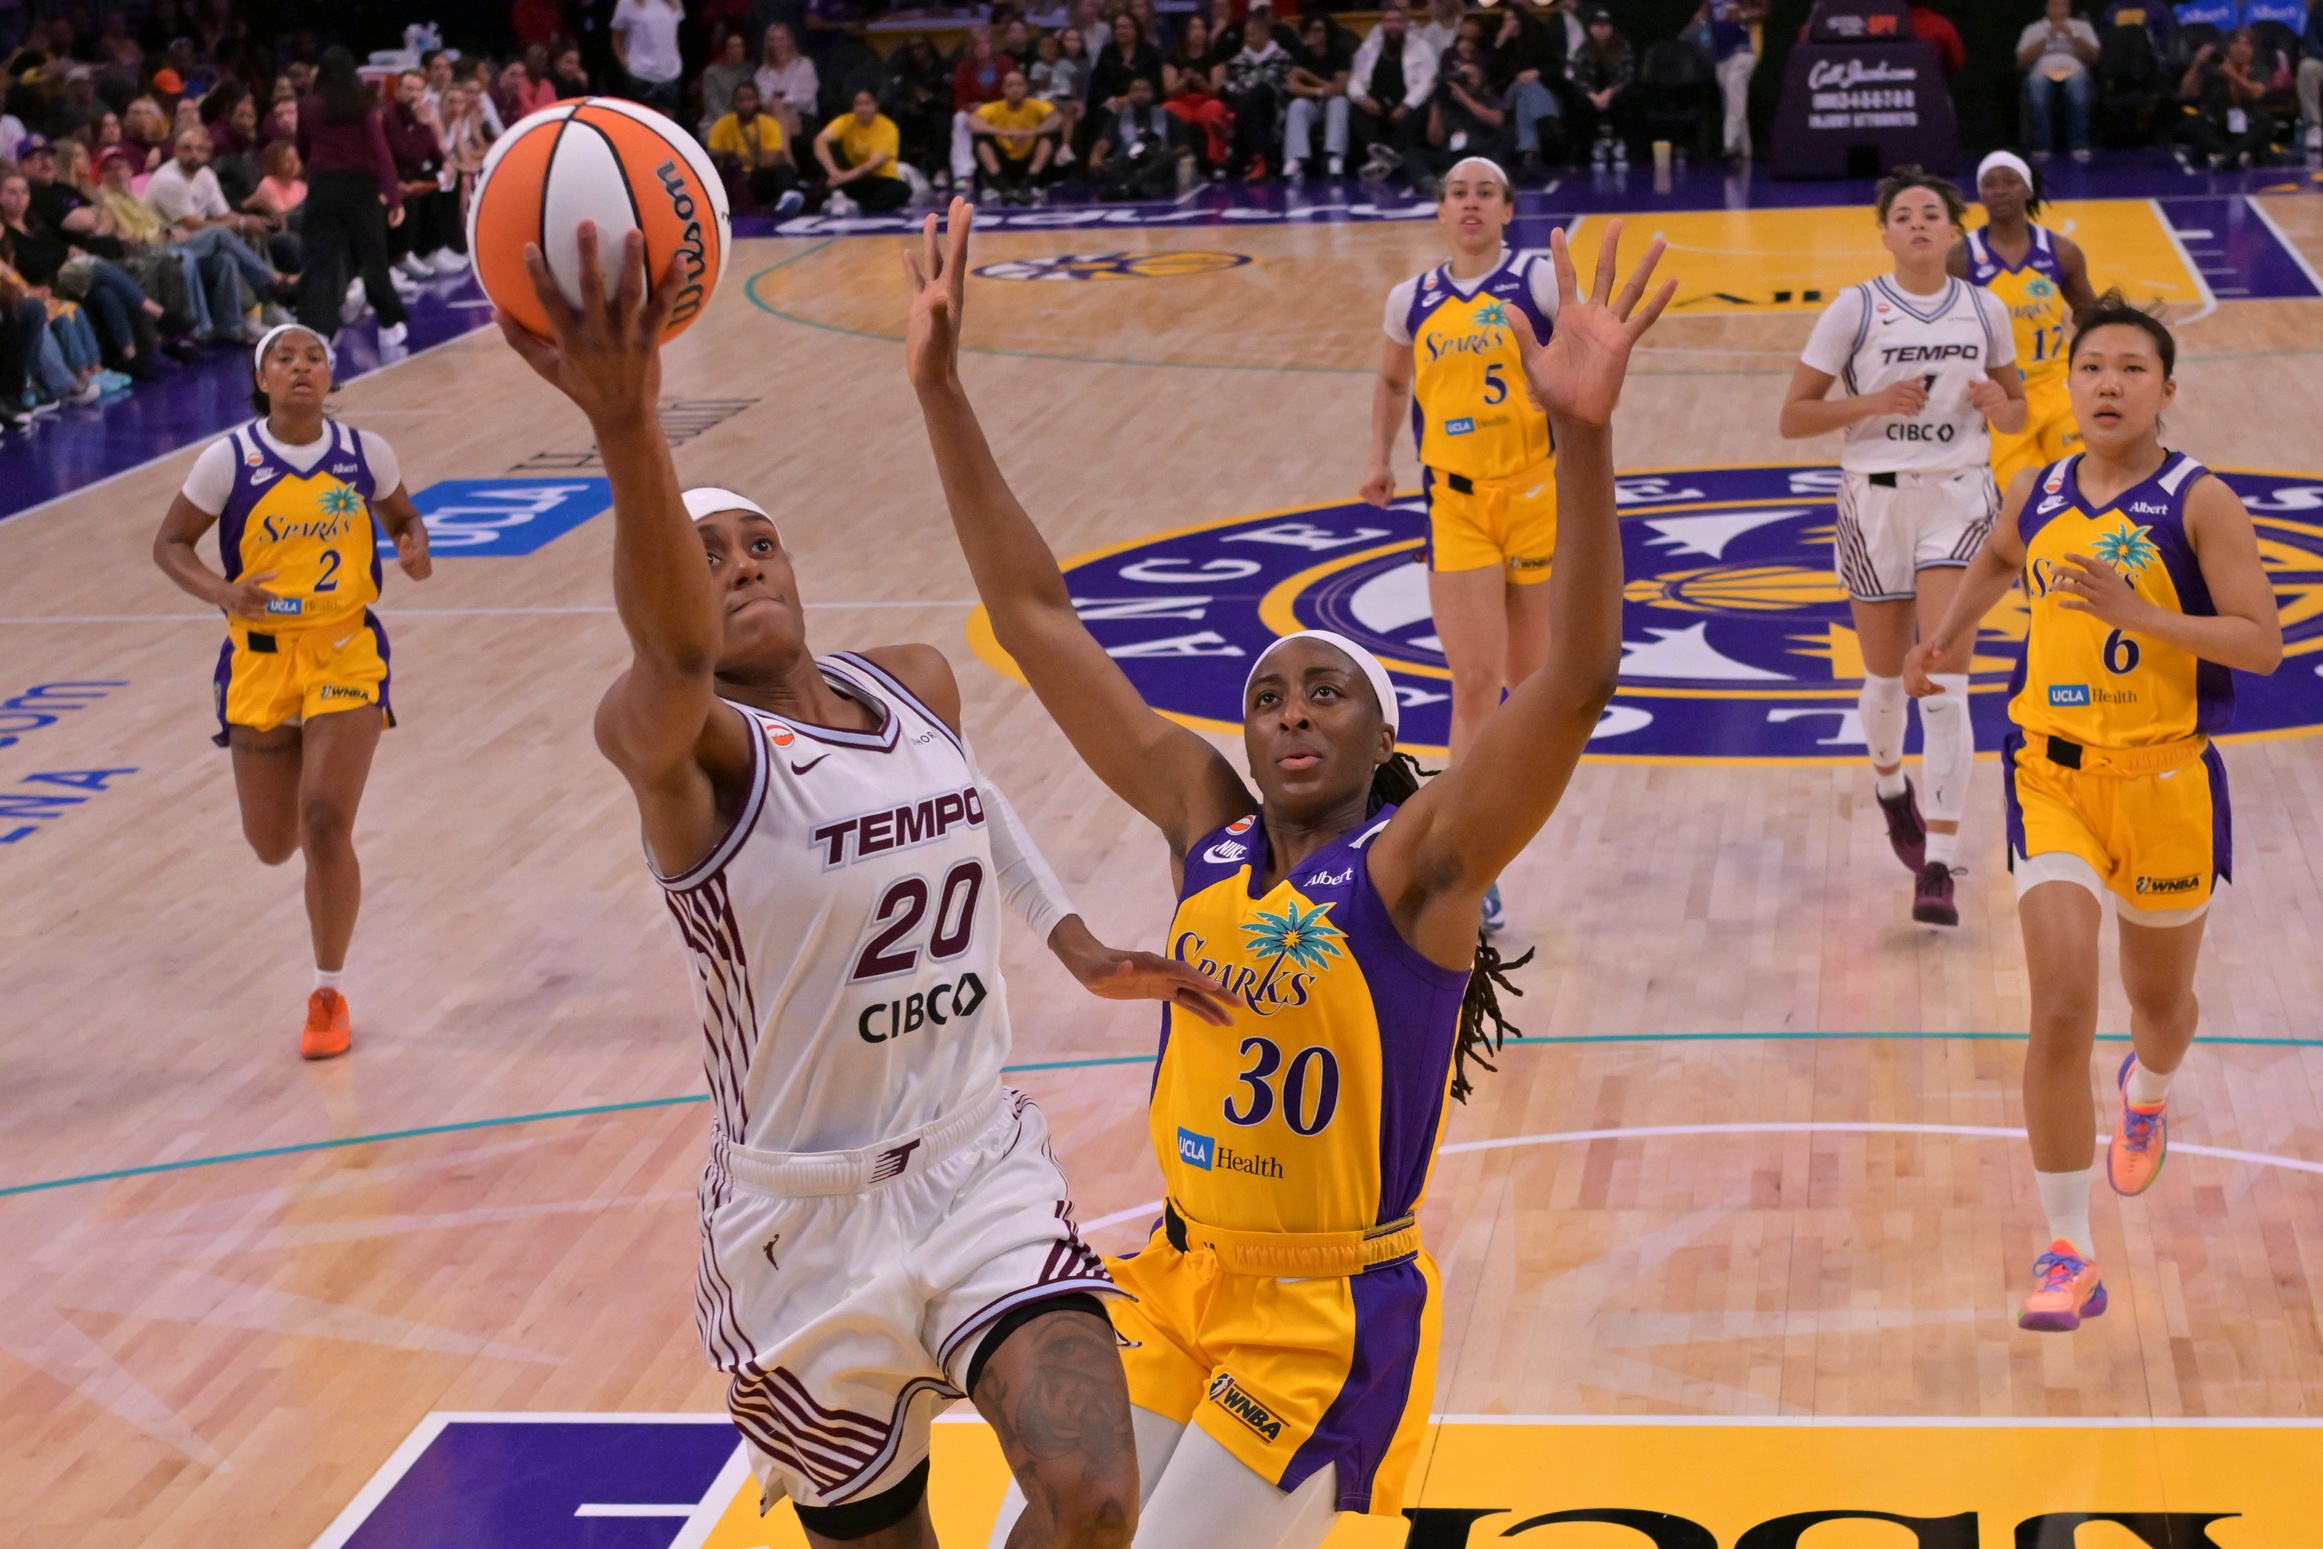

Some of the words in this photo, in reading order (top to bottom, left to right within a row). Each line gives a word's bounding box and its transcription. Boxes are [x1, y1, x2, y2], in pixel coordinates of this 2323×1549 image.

[1425, 332, 1506, 363] SPARKS
[1882, 344, 1980, 365] TEMPO
[2032, 325, 2063, 362] 17
[1483, 364, 1507, 405] 5
[1886, 424, 1934, 441] CIBC
[2129, 501, 2169, 516] Albert
[259, 514, 351, 544] SPARKS
[313, 549, 342, 593] 2
[270, 601, 298, 612] UCLA
[2102, 628, 2140, 675] 6
[331, 686, 370, 701] WNBA
[2052, 689, 2084, 702] UCLA
[2092, 688, 2138, 704] Health
[810, 785, 985, 868] TEMPO
[1214, 839, 1248, 860] NIKE
[1303, 866, 1354, 888] Albert
[2151, 876, 2200, 892] WNBA
[850, 859, 986, 982] 20
[858, 983, 953, 1044] CIBC
[1223, 1035, 1340, 1137] 30
[1178, 1136, 1207, 1163] UCLA
[1216, 1146, 1284, 1180] Health
[1223, 1387, 1282, 1441] WNBA
